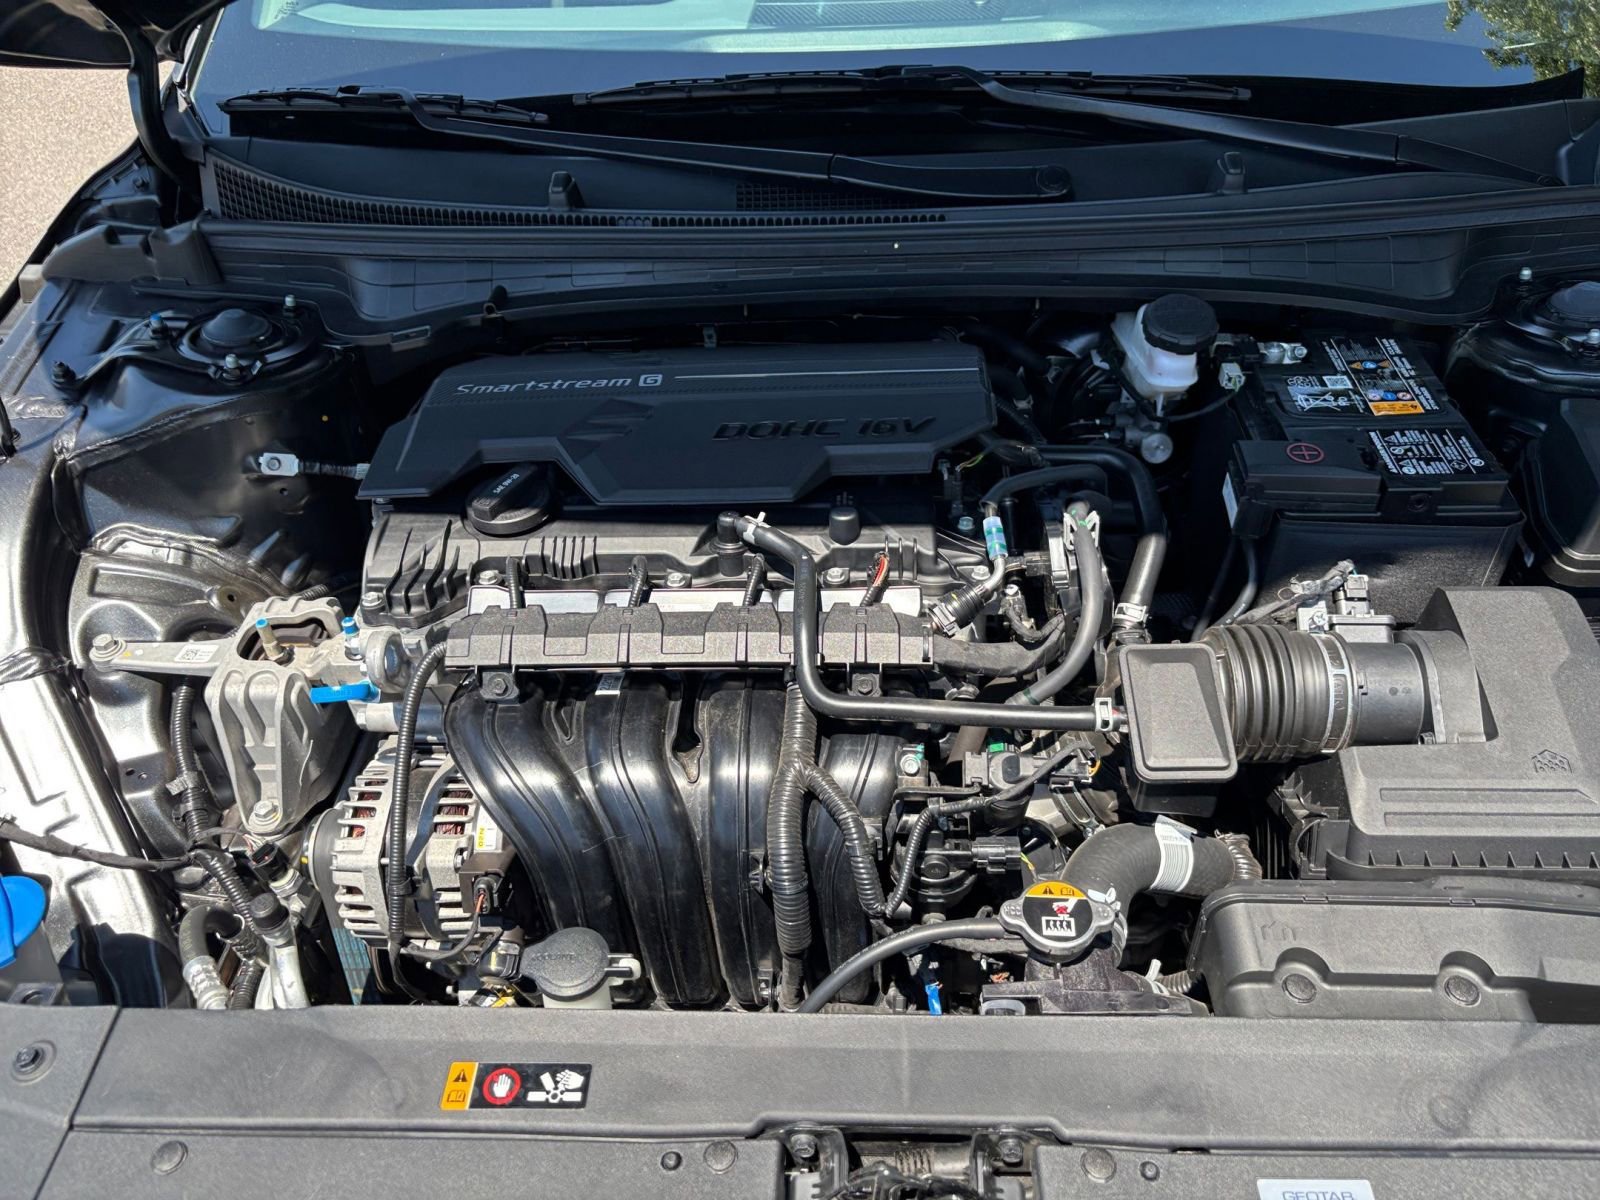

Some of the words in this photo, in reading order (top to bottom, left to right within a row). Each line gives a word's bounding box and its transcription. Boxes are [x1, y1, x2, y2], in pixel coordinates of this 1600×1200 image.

[457, 377, 631, 396] Smartstream
[712, 419, 845, 442] DOHC
[856, 416, 936, 438] 16V
